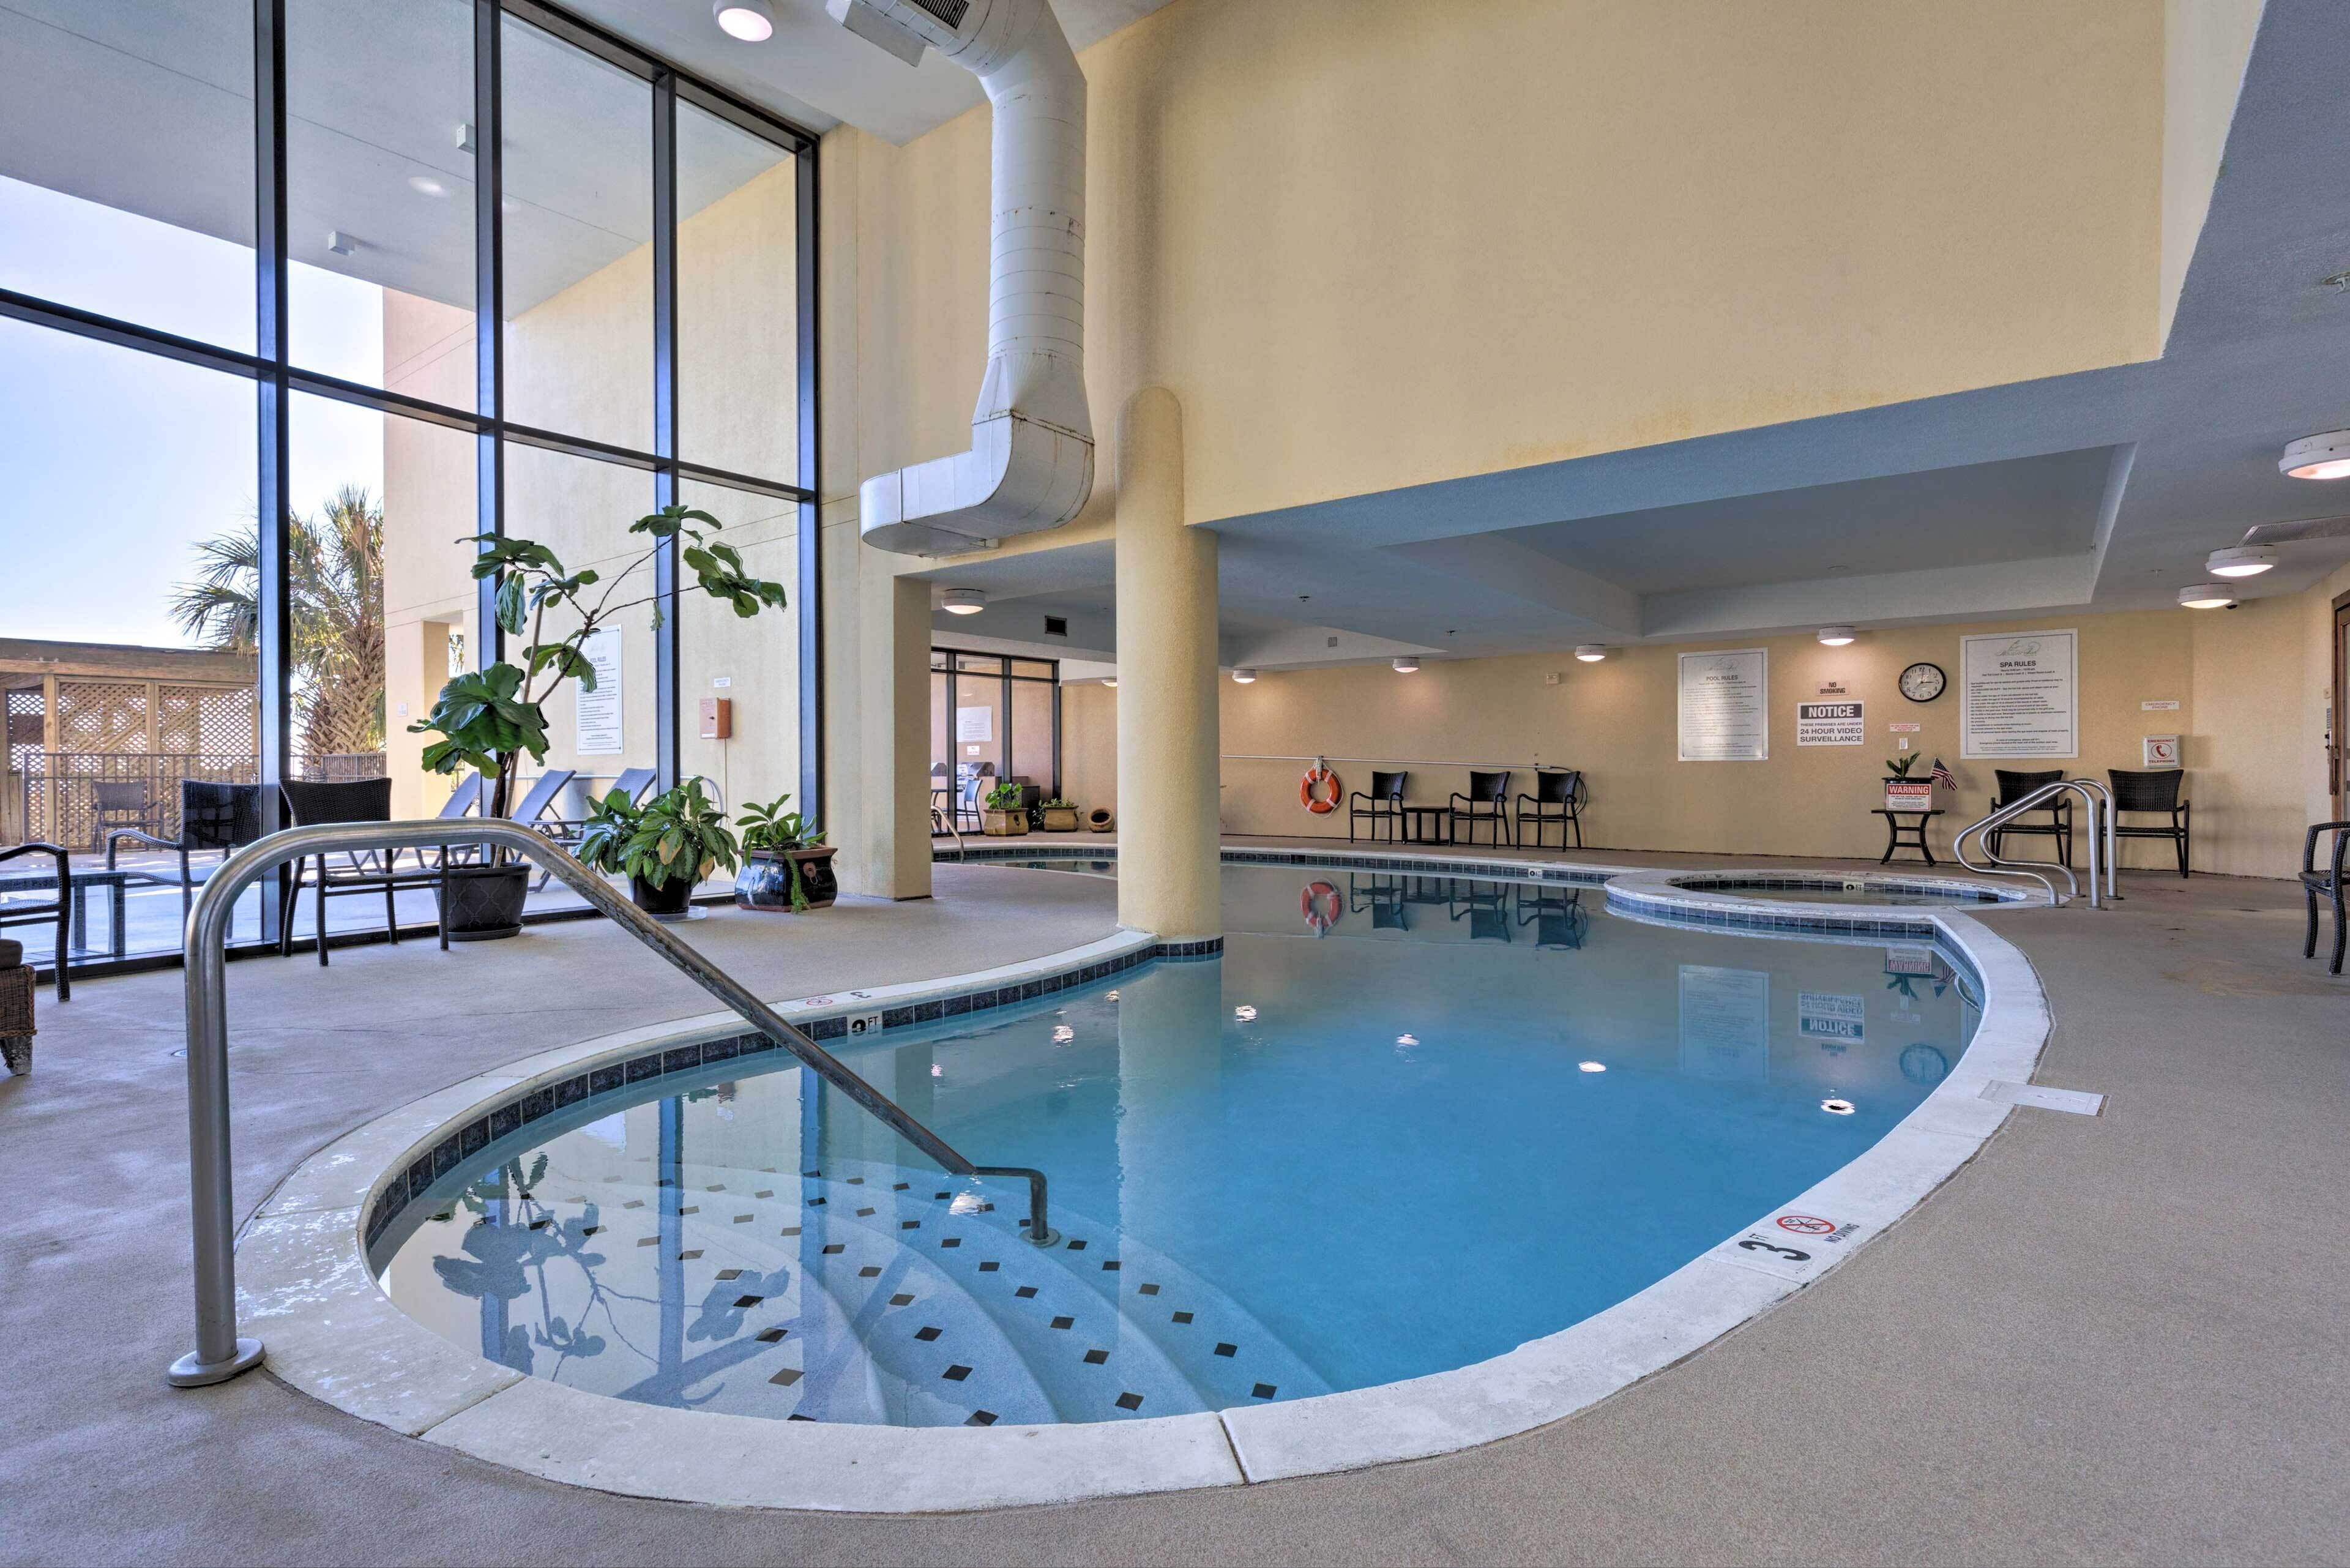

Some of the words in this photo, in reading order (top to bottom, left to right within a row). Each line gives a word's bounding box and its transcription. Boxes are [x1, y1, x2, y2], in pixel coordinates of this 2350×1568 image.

[1808, 705, 1854, 718] NOTICE
[1889, 786, 1929, 794] WARNING
[868, 1016, 879, 1026] FT
[1824, 1235, 1842, 1244] NO
[1833, 1223, 1860, 1238] DIVING
[1738, 1240, 1811, 1261] 3
